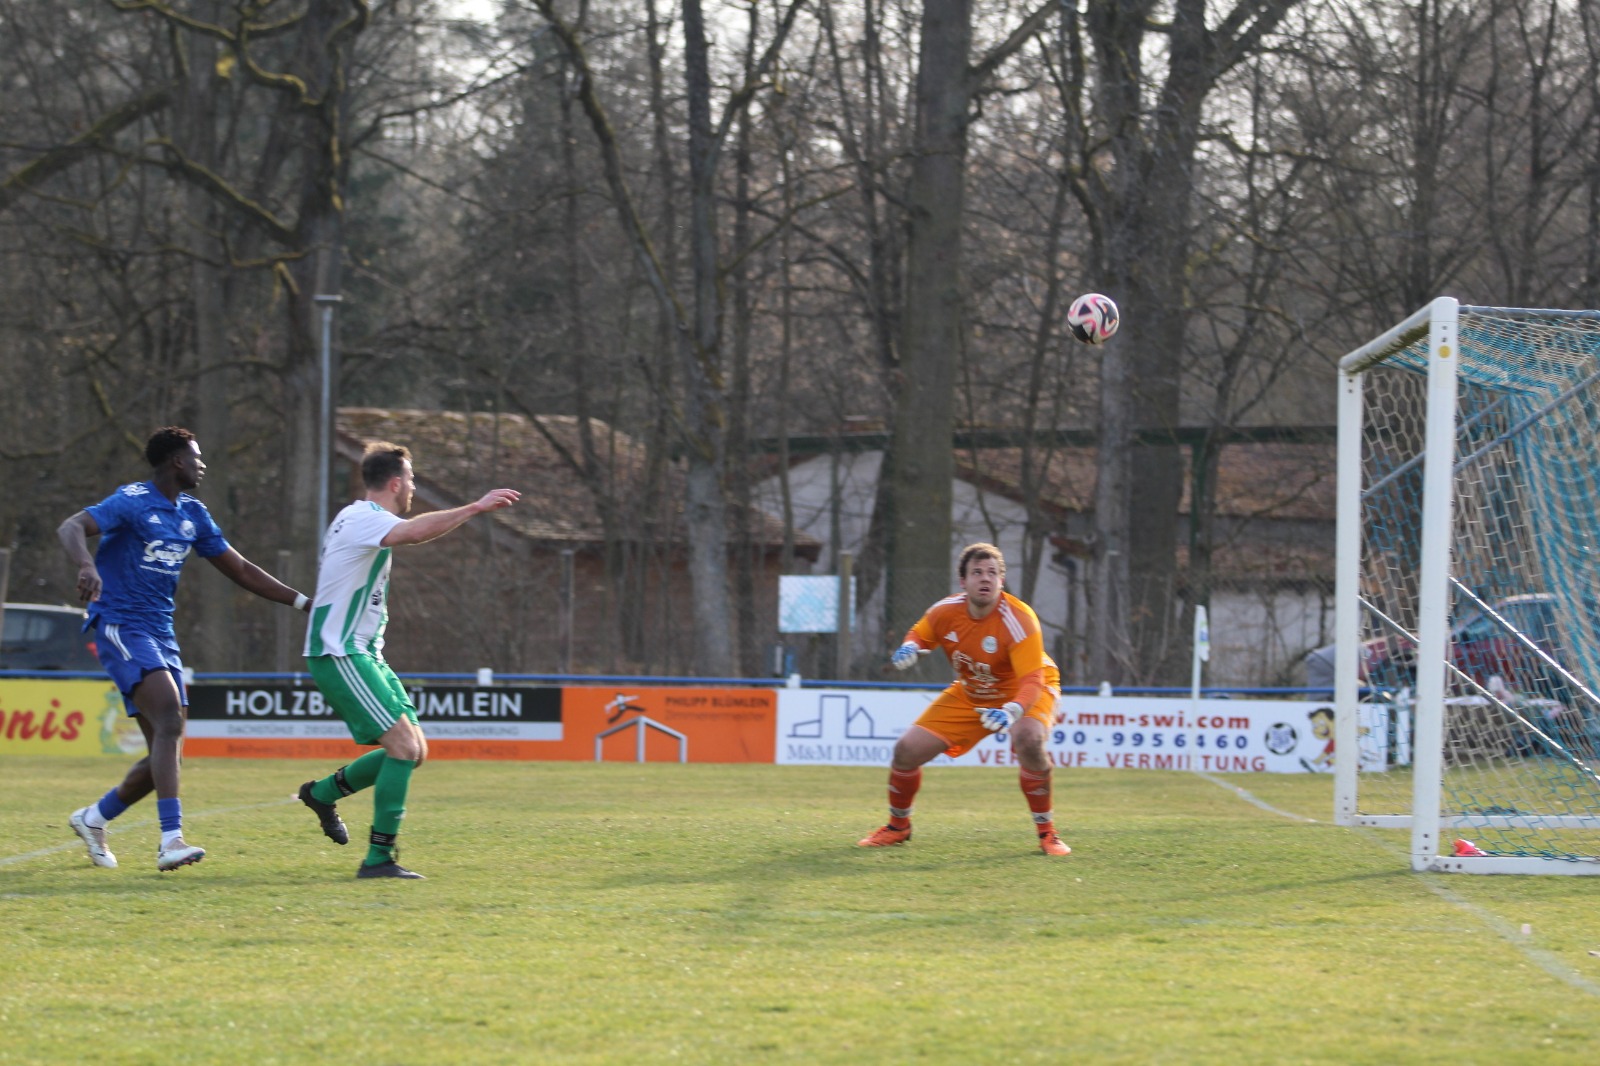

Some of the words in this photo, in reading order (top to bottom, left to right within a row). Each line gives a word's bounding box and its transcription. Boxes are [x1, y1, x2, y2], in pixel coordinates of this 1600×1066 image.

[407, 686, 522, 717] ÜMLEIN
[0, 697, 85, 741] nis
[1054, 711, 1249, 729] w.mm-swi.com
[786, 744, 832, 761] M&M
[838, 745, 894, 763] IMMO
[1106, 752, 1266, 772] VERMITUNG
